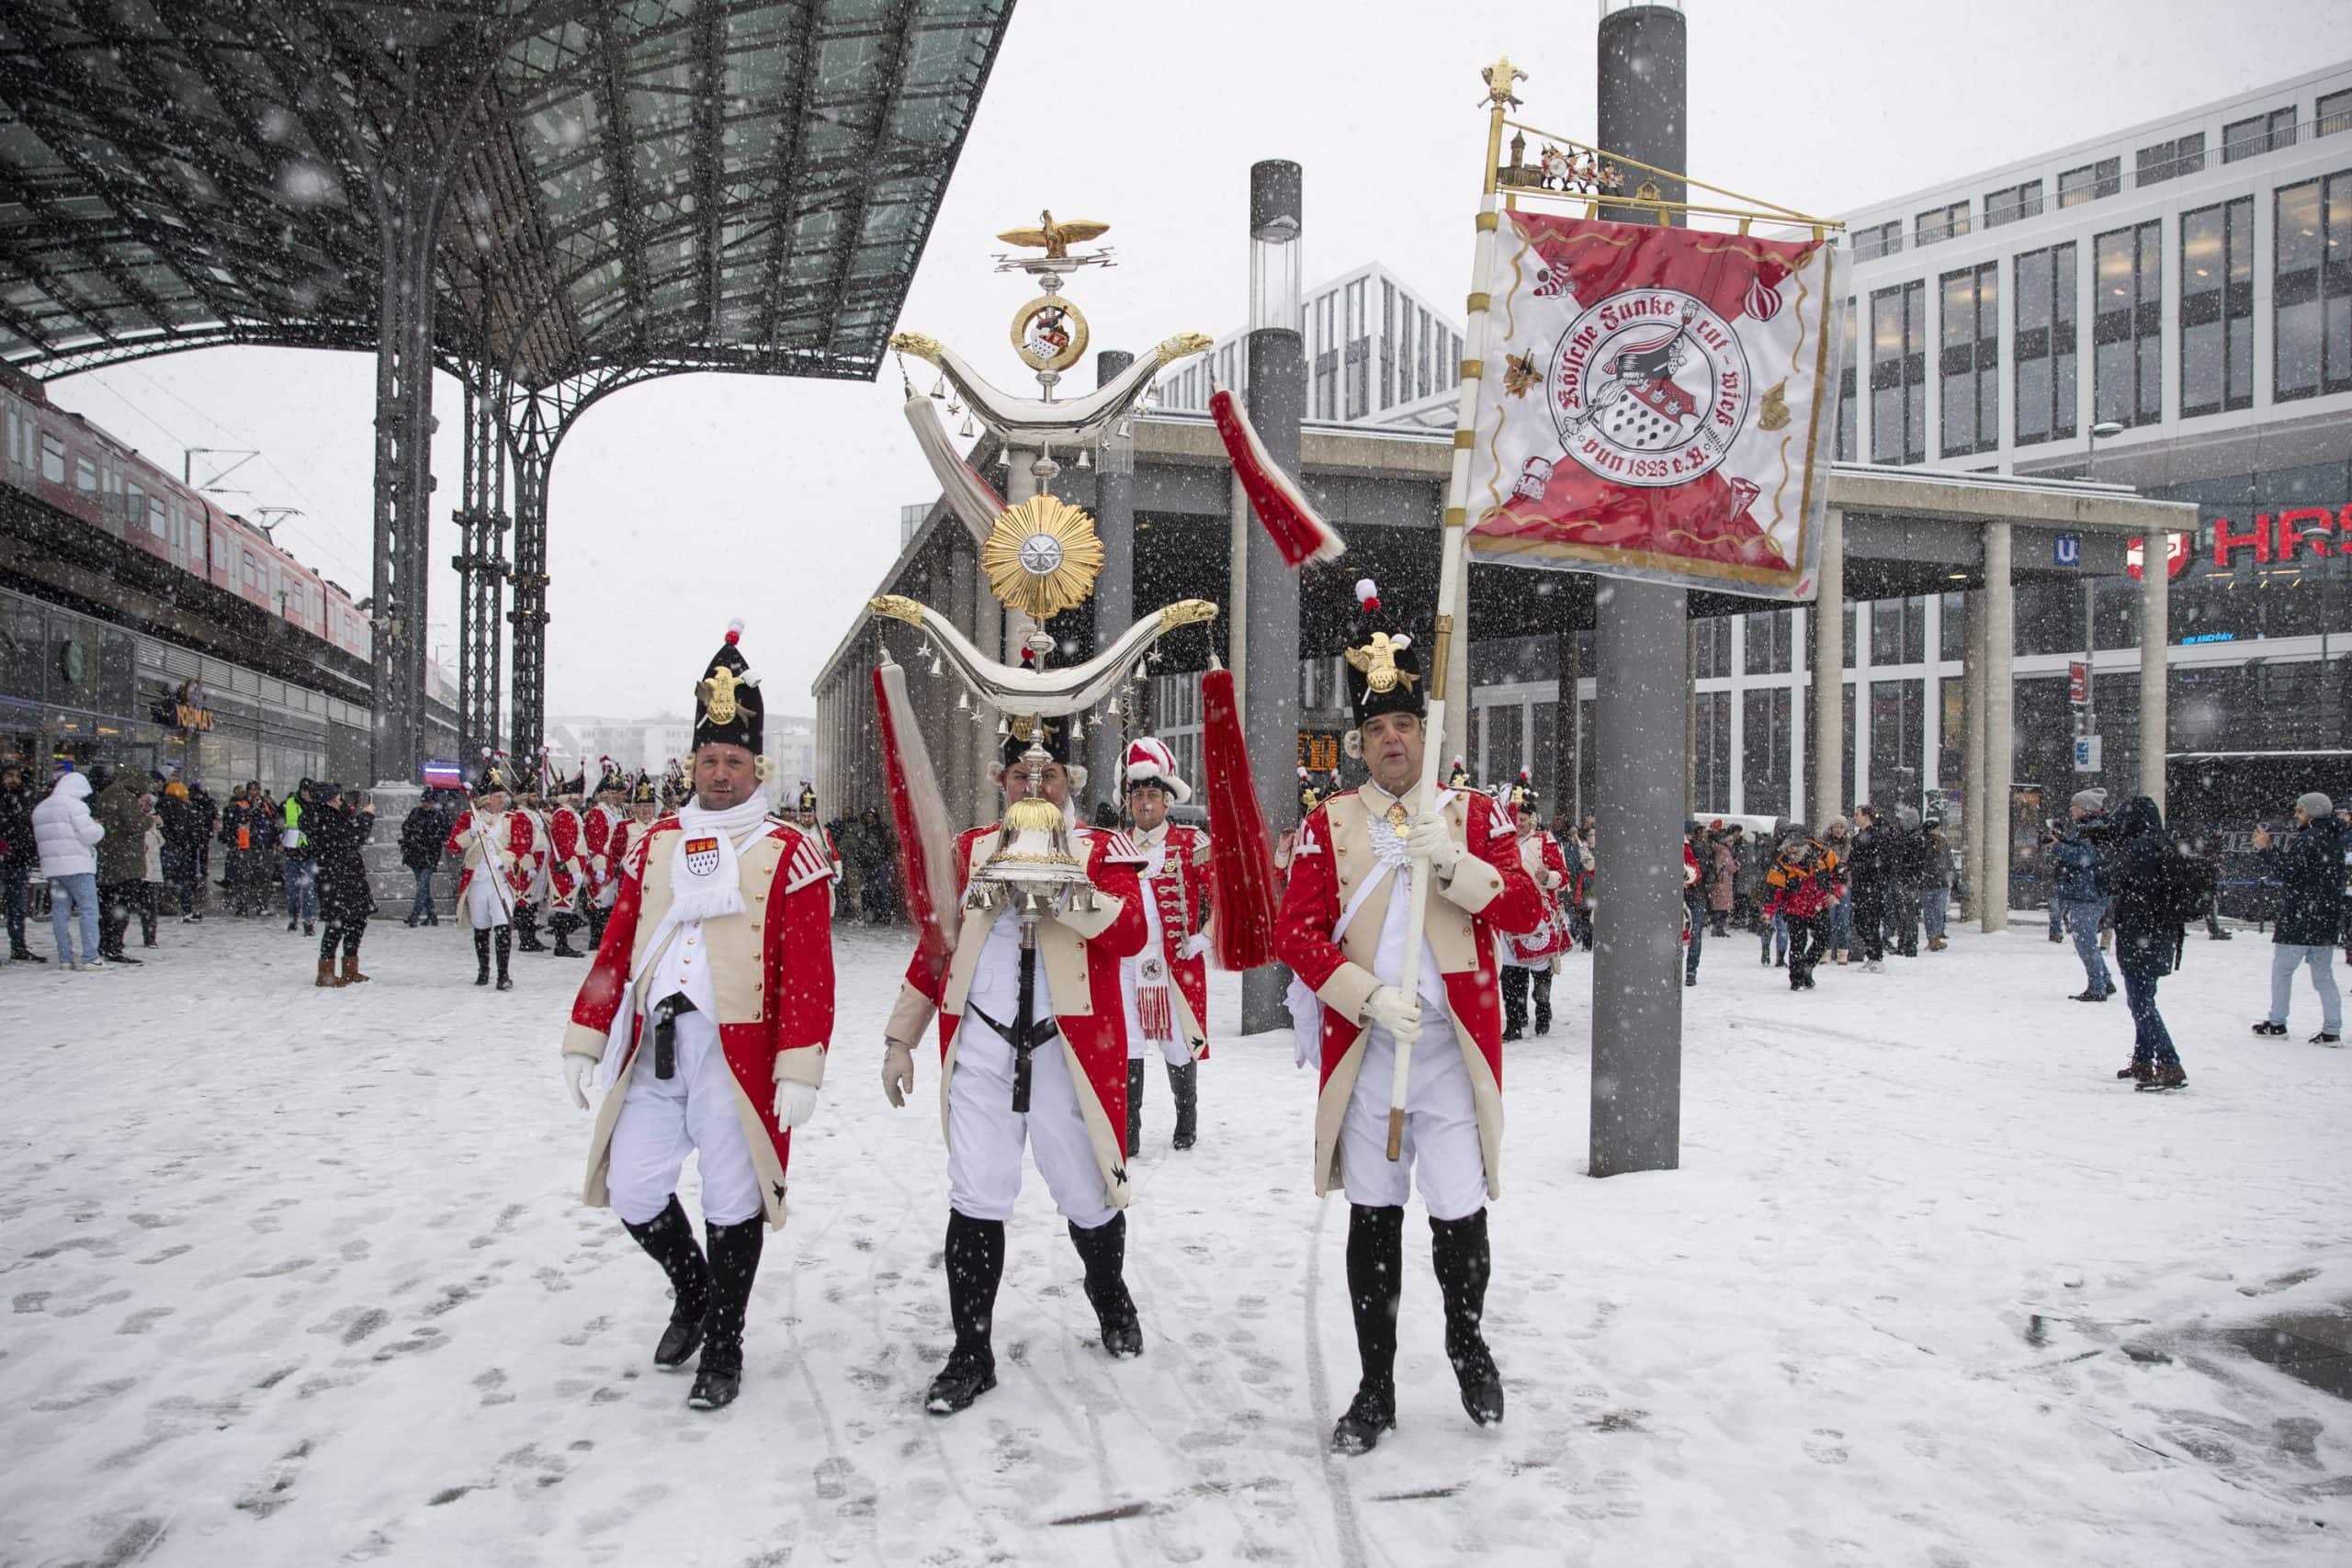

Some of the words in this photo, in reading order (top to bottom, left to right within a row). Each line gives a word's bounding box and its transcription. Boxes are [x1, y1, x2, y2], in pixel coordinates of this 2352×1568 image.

[1600, 296, 1675, 330] Funke
[1696, 320, 1730, 351] rut
[1582, 437, 1625, 471] vun
[1627, 456, 1668, 477] 1823
[2214, 502, 2352, 567] HR
